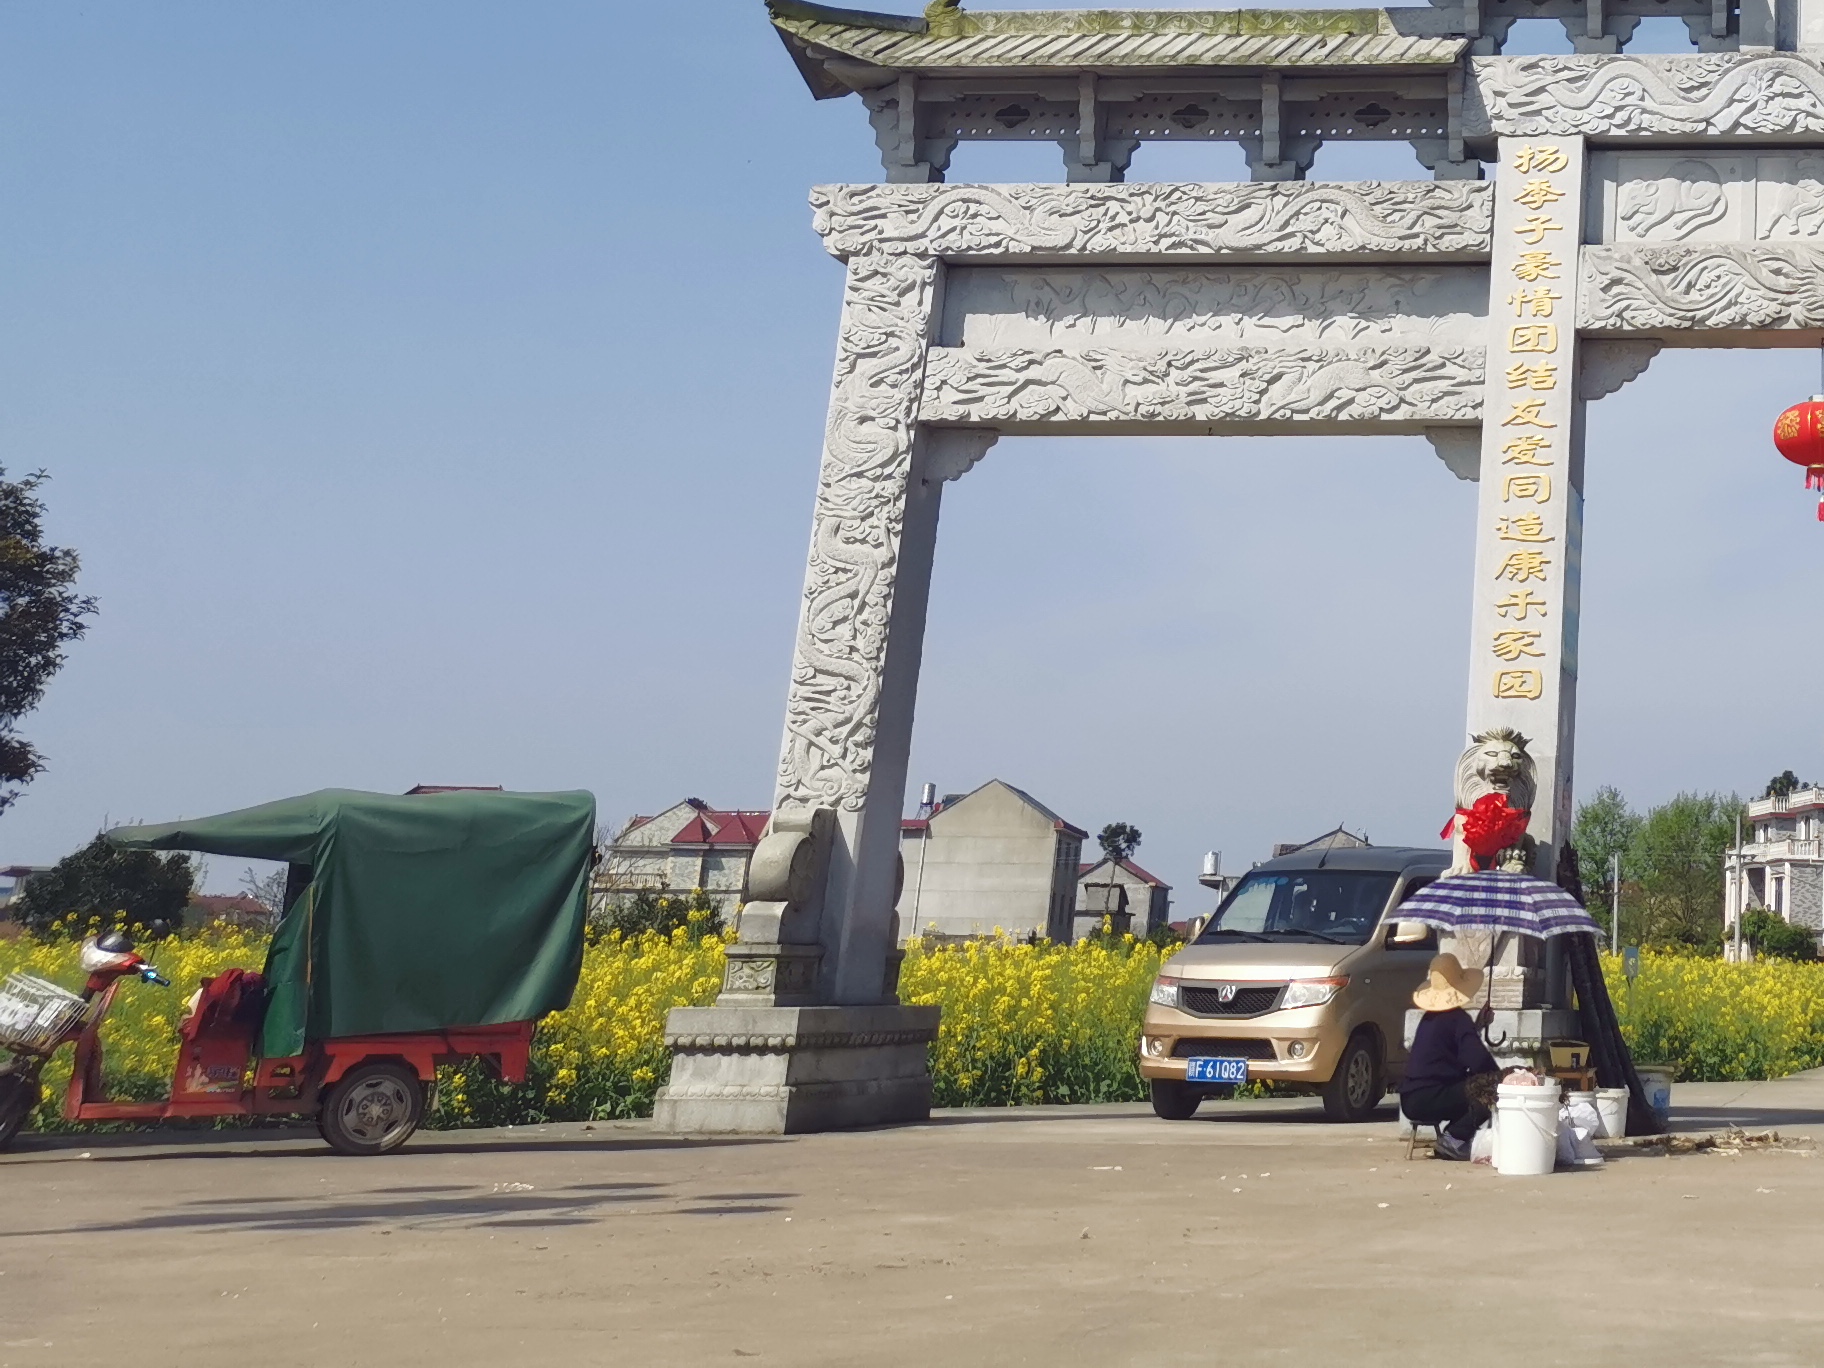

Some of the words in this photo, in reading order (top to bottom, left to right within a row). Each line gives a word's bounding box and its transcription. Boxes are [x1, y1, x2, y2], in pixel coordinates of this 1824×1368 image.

[1491, 143, 1570, 701] 扬季子豪情团结友爱同造康乐家园
